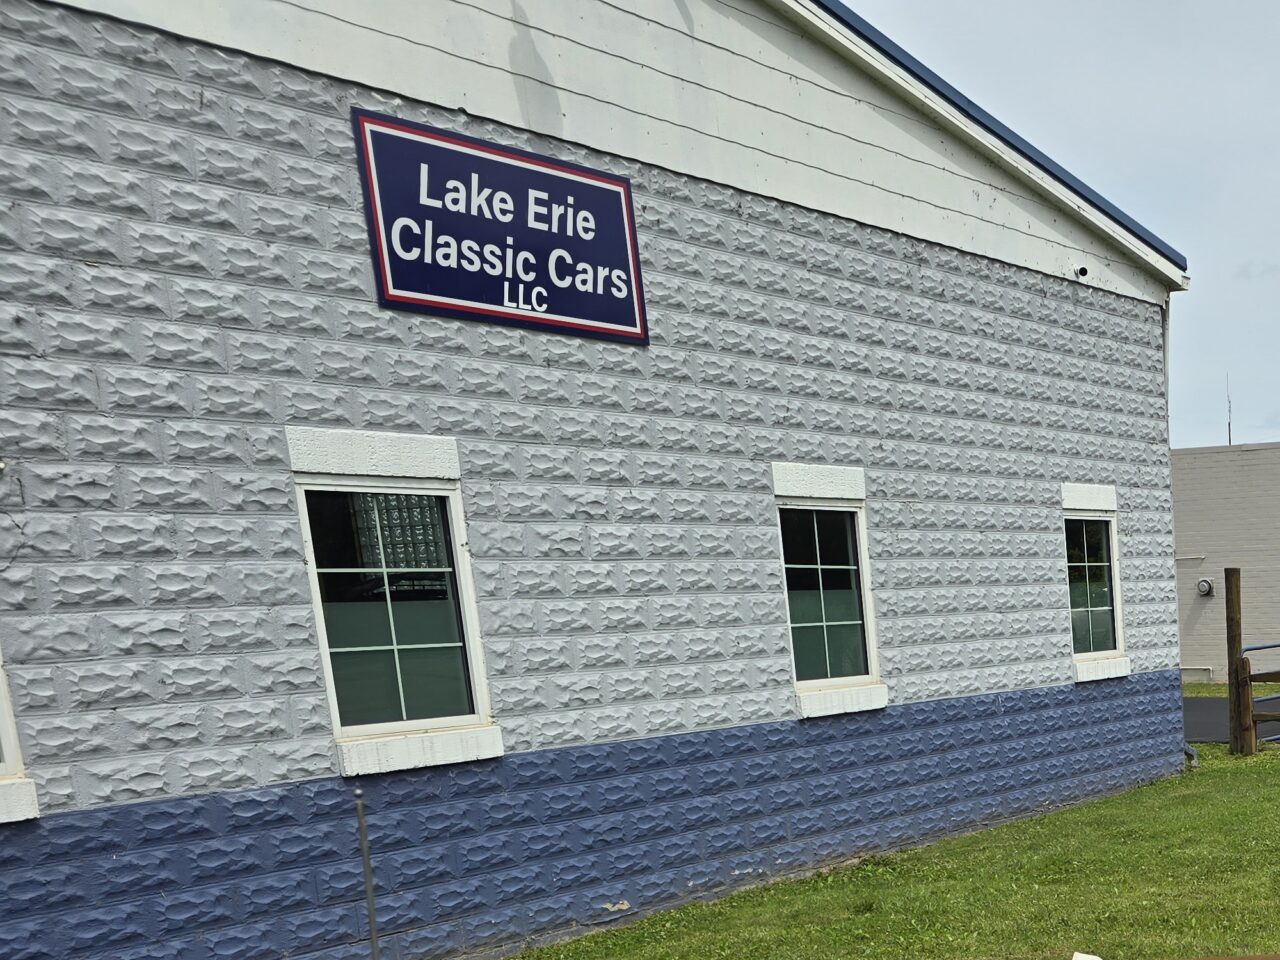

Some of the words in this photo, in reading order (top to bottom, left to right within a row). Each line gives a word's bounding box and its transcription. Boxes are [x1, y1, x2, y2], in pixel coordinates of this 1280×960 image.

[419, 163, 514, 223] Lake
[527, 188, 596, 241] Erie
[391, 217, 537, 282] Classic
[548, 248, 628, 299] Cars
[503, 281, 548, 312] LLC
